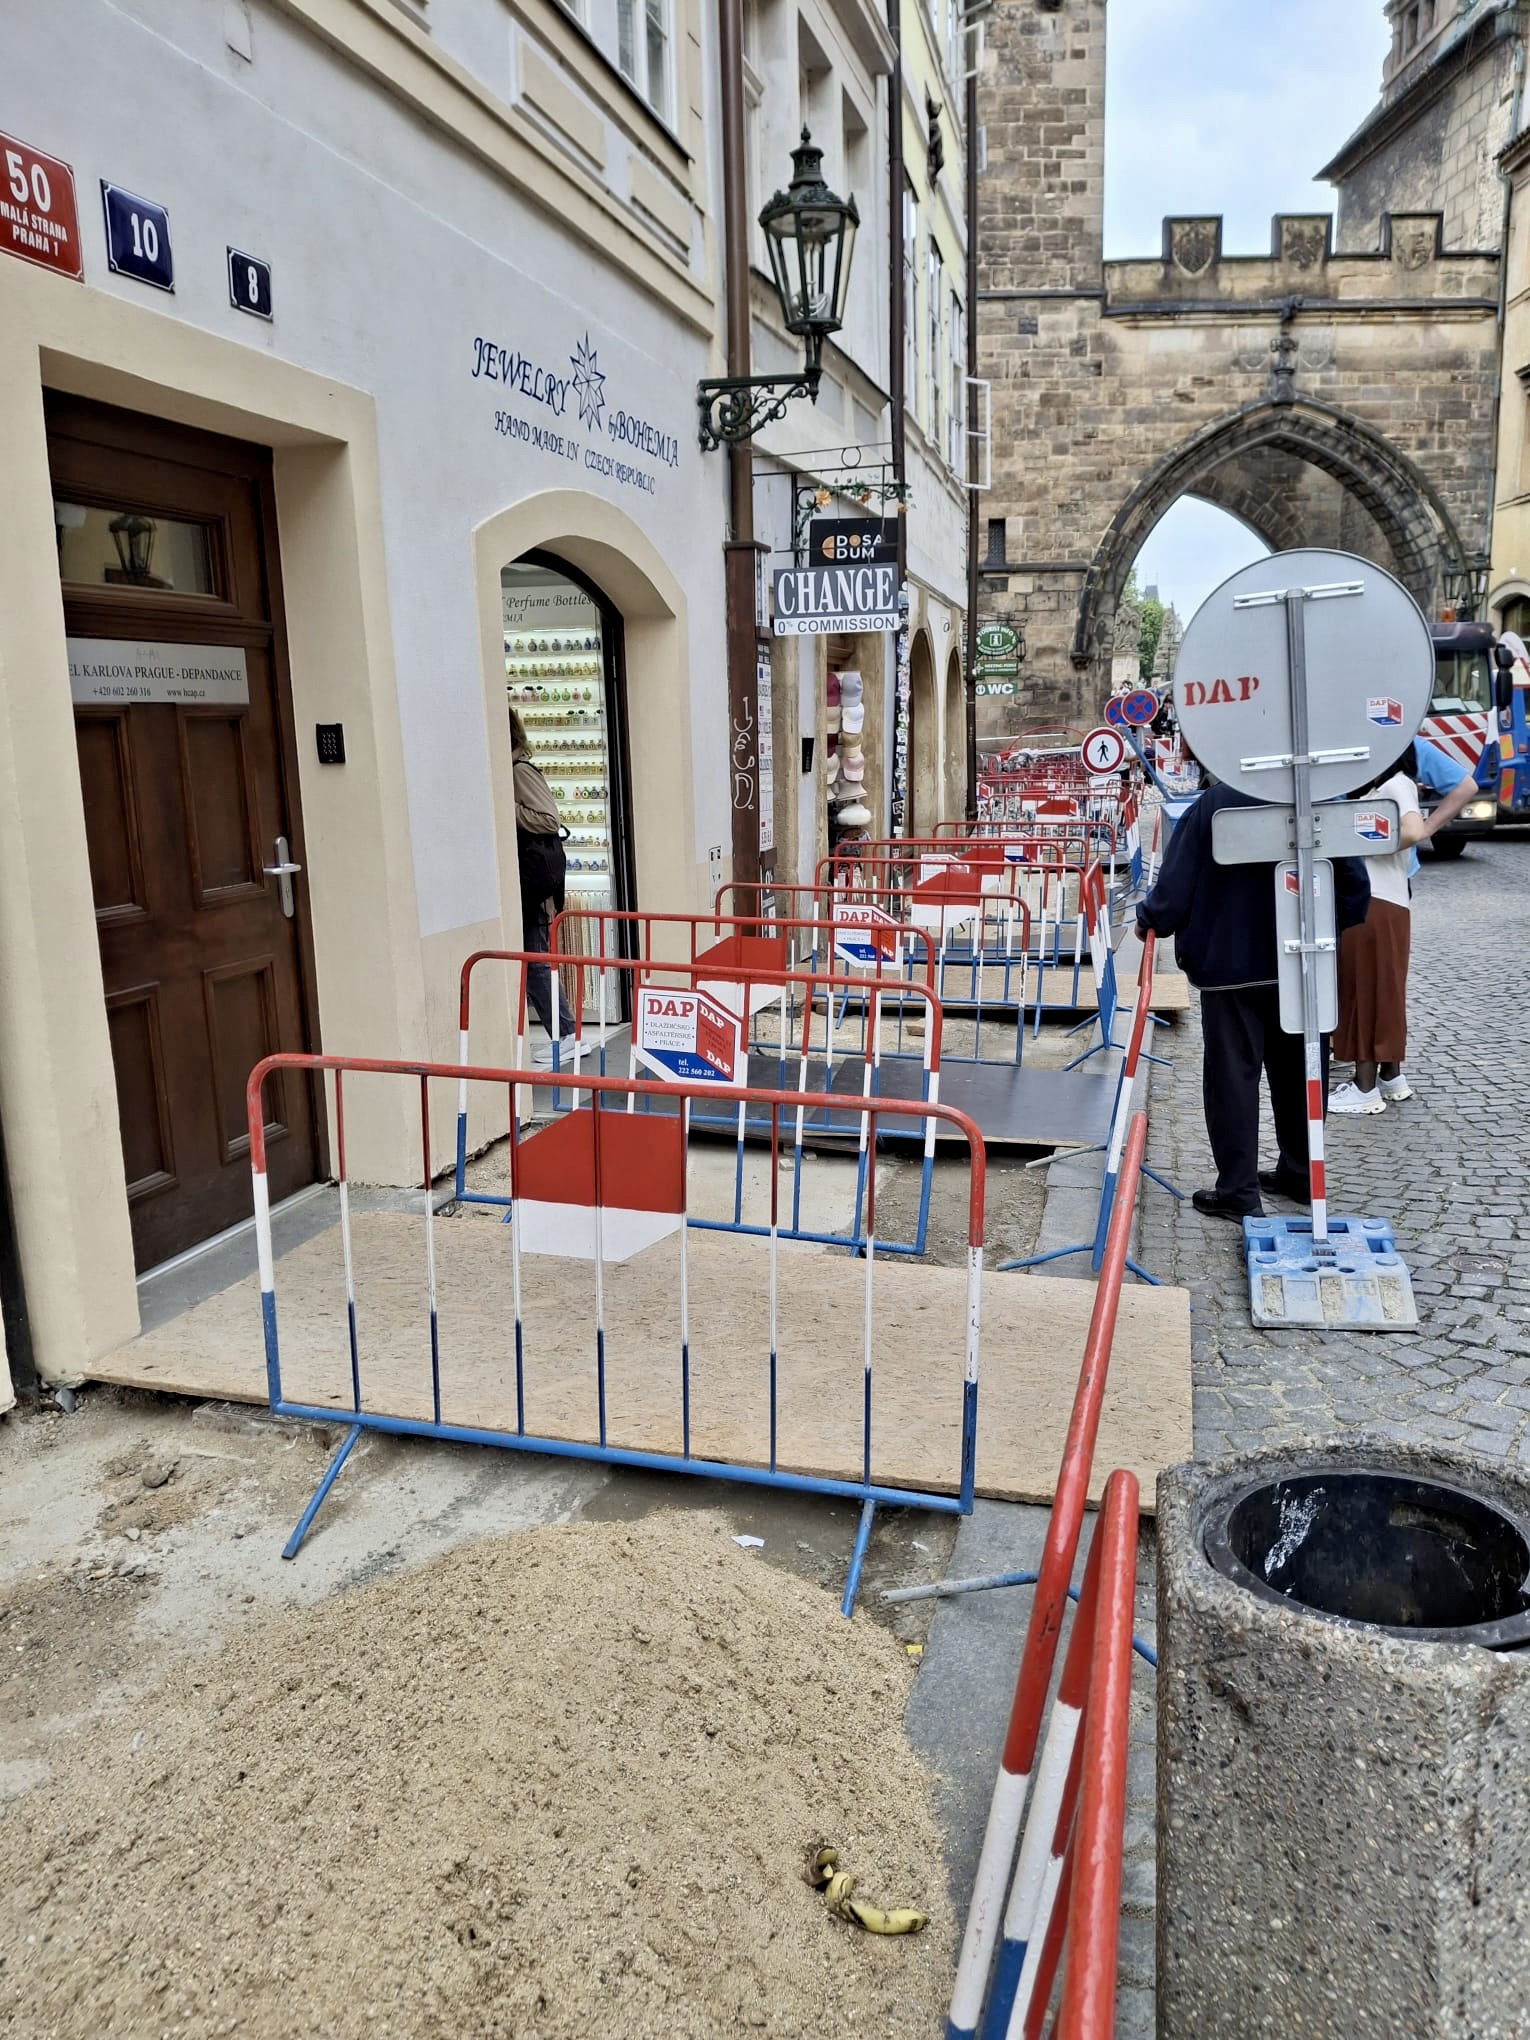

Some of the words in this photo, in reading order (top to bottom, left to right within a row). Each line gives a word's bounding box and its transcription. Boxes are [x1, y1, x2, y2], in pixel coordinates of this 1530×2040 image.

[5, 149, 51, 213] 50
[0, 201, 29, 226] MALÁ
[31, 214, 68, 242] STRANA
[12, 224, 50, 253] PRAHA
[53, 241, 59, 256] 1
[130, 212, 158, 262] 10
[247, 266, 259, 303] 8
[471, 337, 570, 416] JEWELRY
[616, 411, 679, 467] BOHEMIA
[495, 410, 531, 441] HAND
[532, 426, 564, 456] MADE
[566, 440, 580, 462] IN
[584, 449, 614, 476] CZECH
[615, 462, 656, 495] REPUBLIC
[836, 534, 885, 547] DOSA
[836, 547, 875, 559] DUM
[506, 594, 551, 612] Perfume
[553, 594, 592, 607] Bottles
[778, 568, 894, 615] CHANGE
[797, 617, 895, 633] COMMISSION
[83, 664, 133, 678] KARLOVA
[135, 666, 175, 679] PRAGUE
[181, 668, 242, 681] DEPANDANCE
[987, 683, 1014, 695] WC
[1184, 676, 1260, 706] DAP
[840, 910, 870, 922] DAP
[647, 998, 695, 1018] DAP
[699, 1003, 725, 1029] DAP
[678, 1058, 689, 1066] tel.
[706, 1050, 732, 1074] DAP
